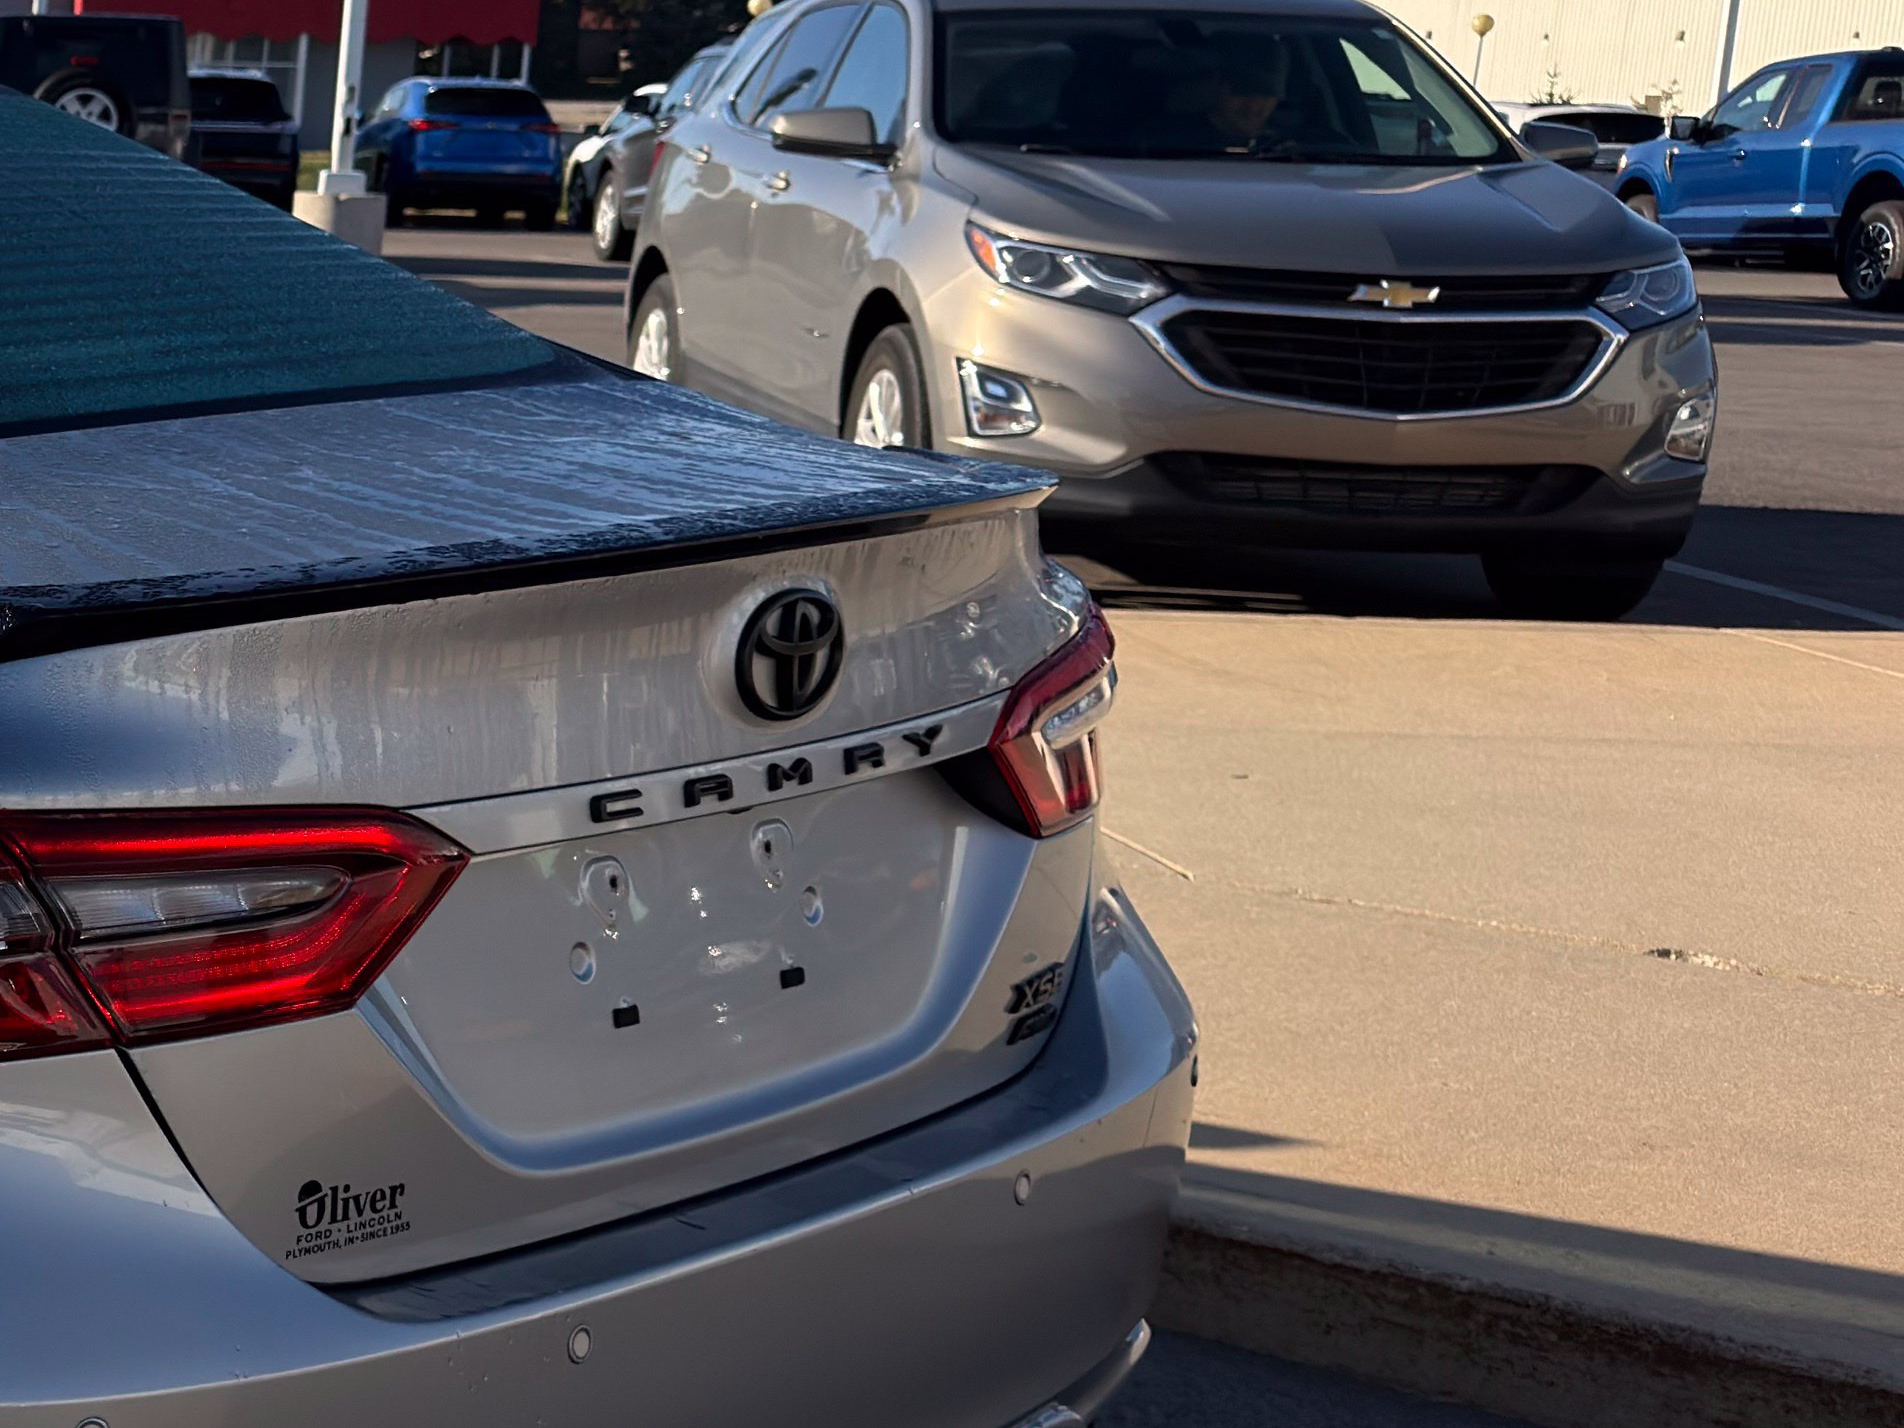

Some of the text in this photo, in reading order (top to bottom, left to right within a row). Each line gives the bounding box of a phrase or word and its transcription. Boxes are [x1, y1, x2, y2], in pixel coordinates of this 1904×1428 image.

[590, 724, 943, 823] CAMRY
[295, 1180, 405, 1229] Oliver
[296, 1211, 402, 1245] FORD LINCOLN
[285, 1239, 342, 1260] PLYMOUTH,
